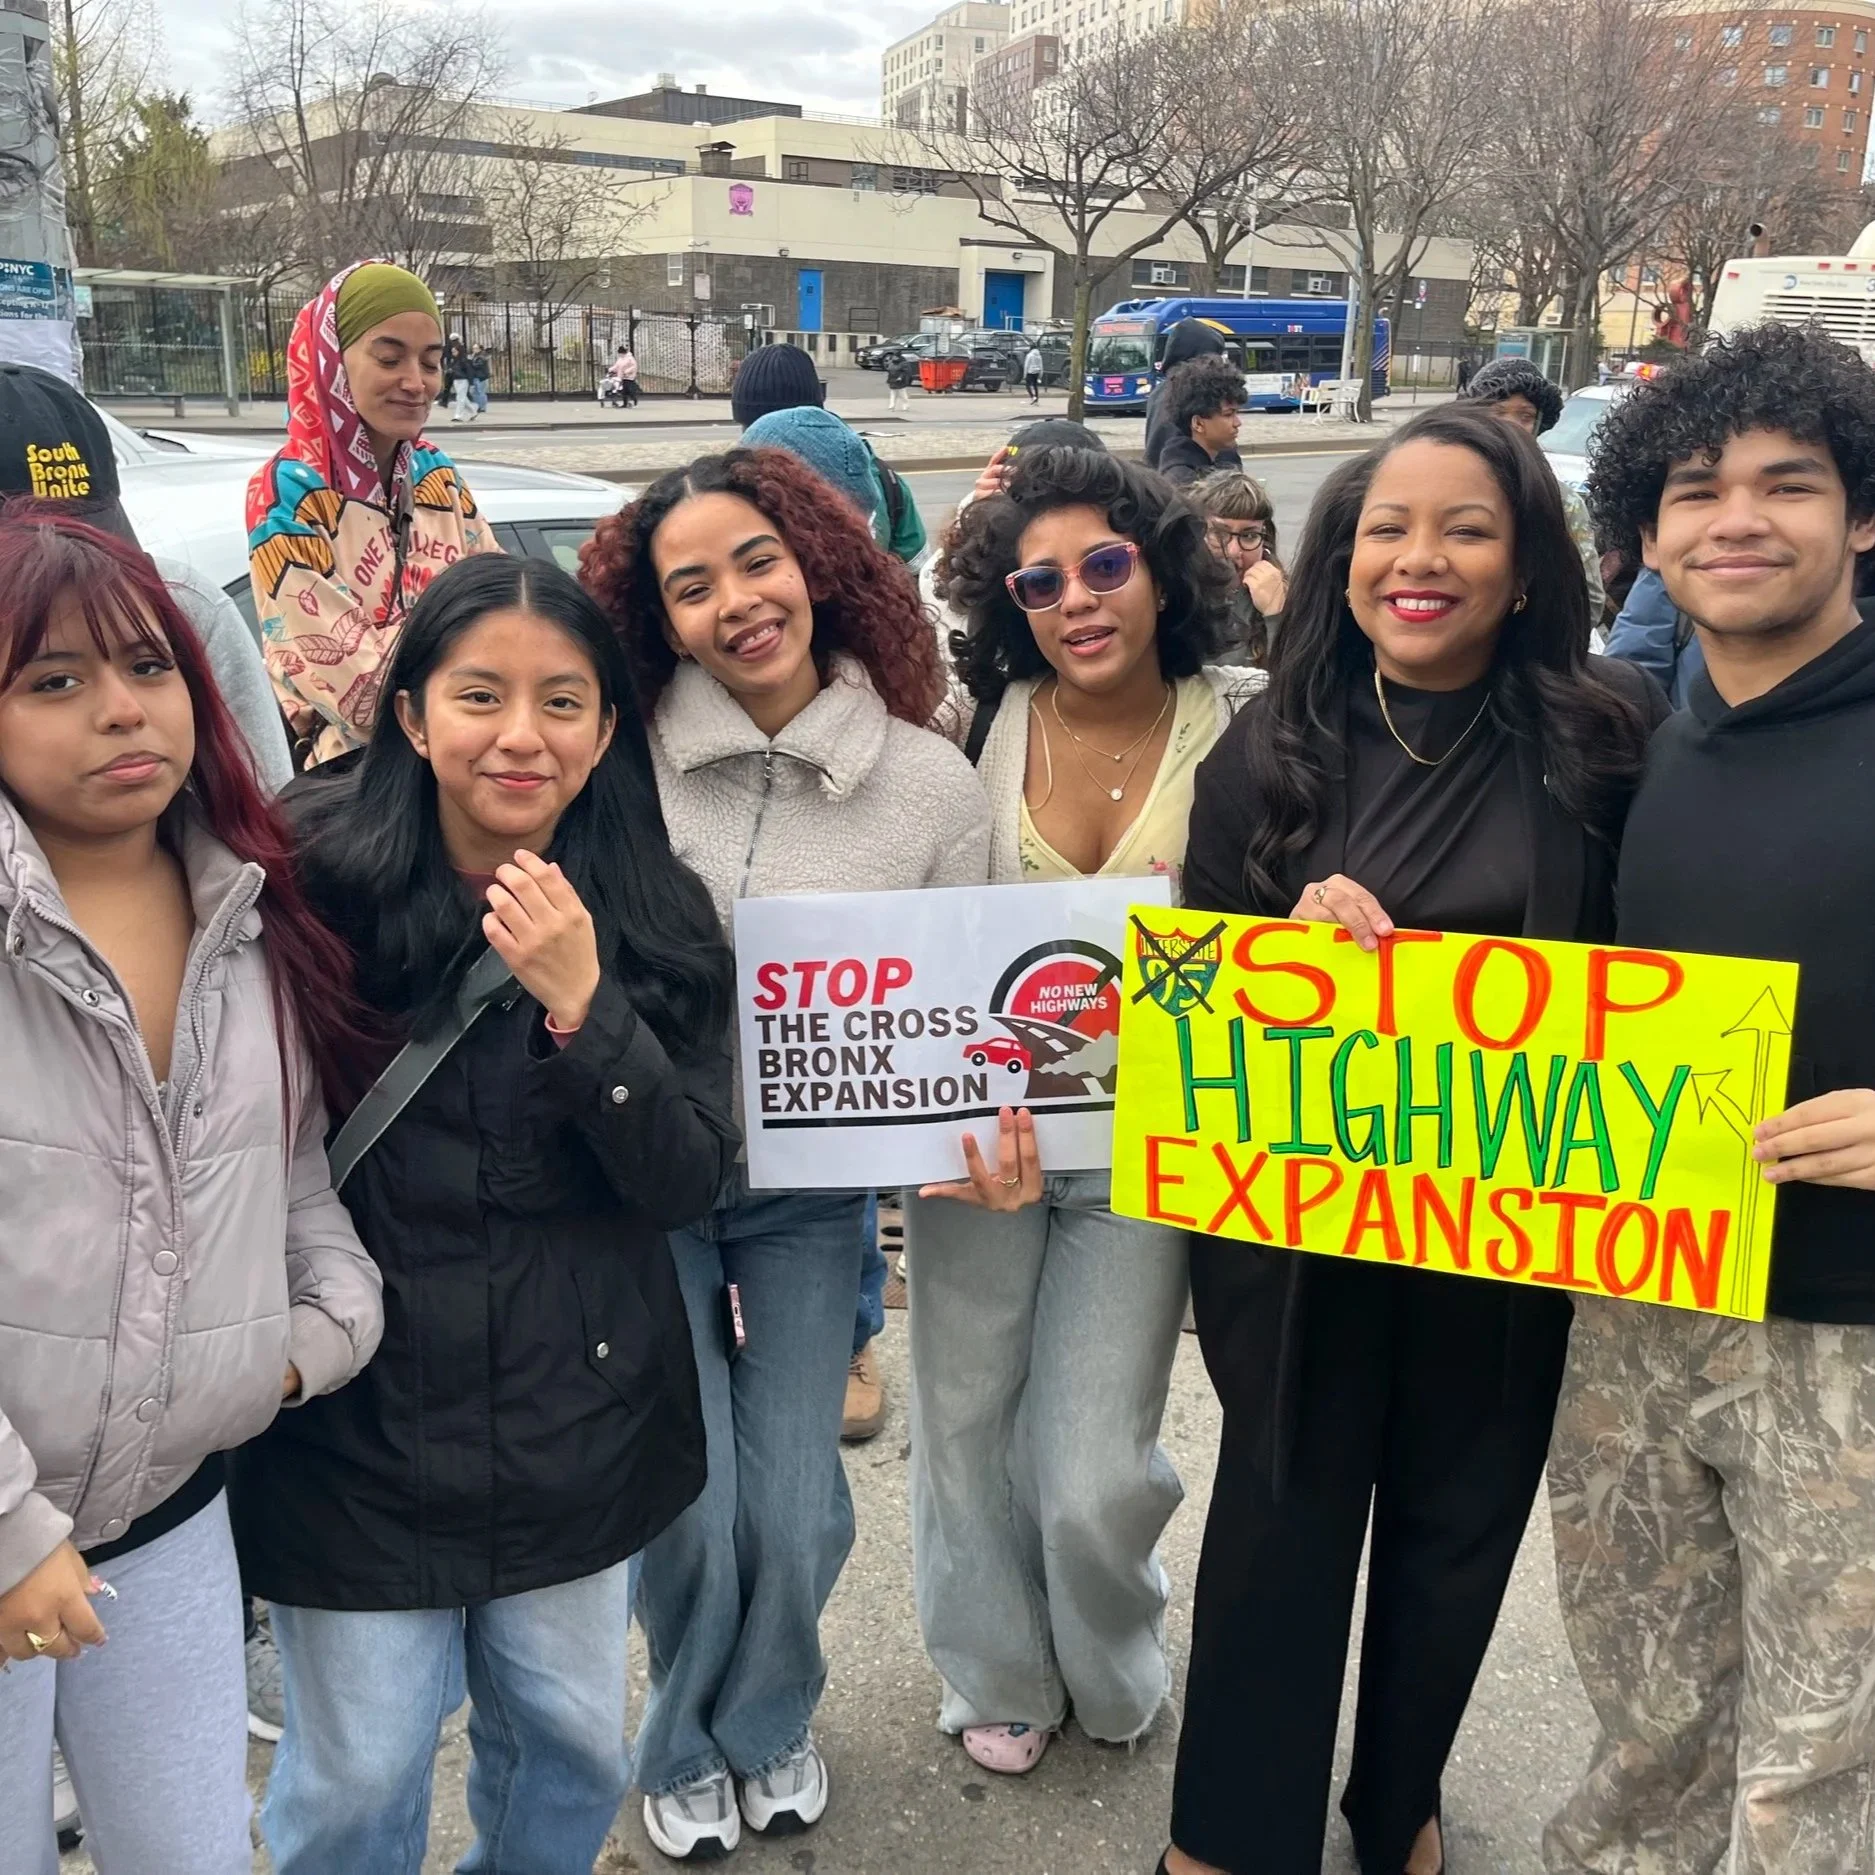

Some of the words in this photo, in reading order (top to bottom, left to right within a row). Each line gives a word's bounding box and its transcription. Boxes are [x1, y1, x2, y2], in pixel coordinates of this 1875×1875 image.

[27, 442, 80, 462] South
[33, 478, 90, 498] Unite
[354, 536, 384, 587] ONE
[753, 957, 912, 1010] STOP
[1038, 986, 1061, 999] NO
[1063, 983, 1098, 997] NEW
[1233, 922, 1683, 1061] STOP
[1030, 996, 1108, 1013] HIGHWAYS
[755, 1013, 830, 1044] THE
[843, 1005, 979, 1040] CROSS
[758, 1044, 895, 1078] BRONX
[761, 1073, 988, 1113] EXPANSION
[1174, 1016, 1691, 1200] HIGHWAY
[1144, 1134, 1731, 1309] EXPANSION
